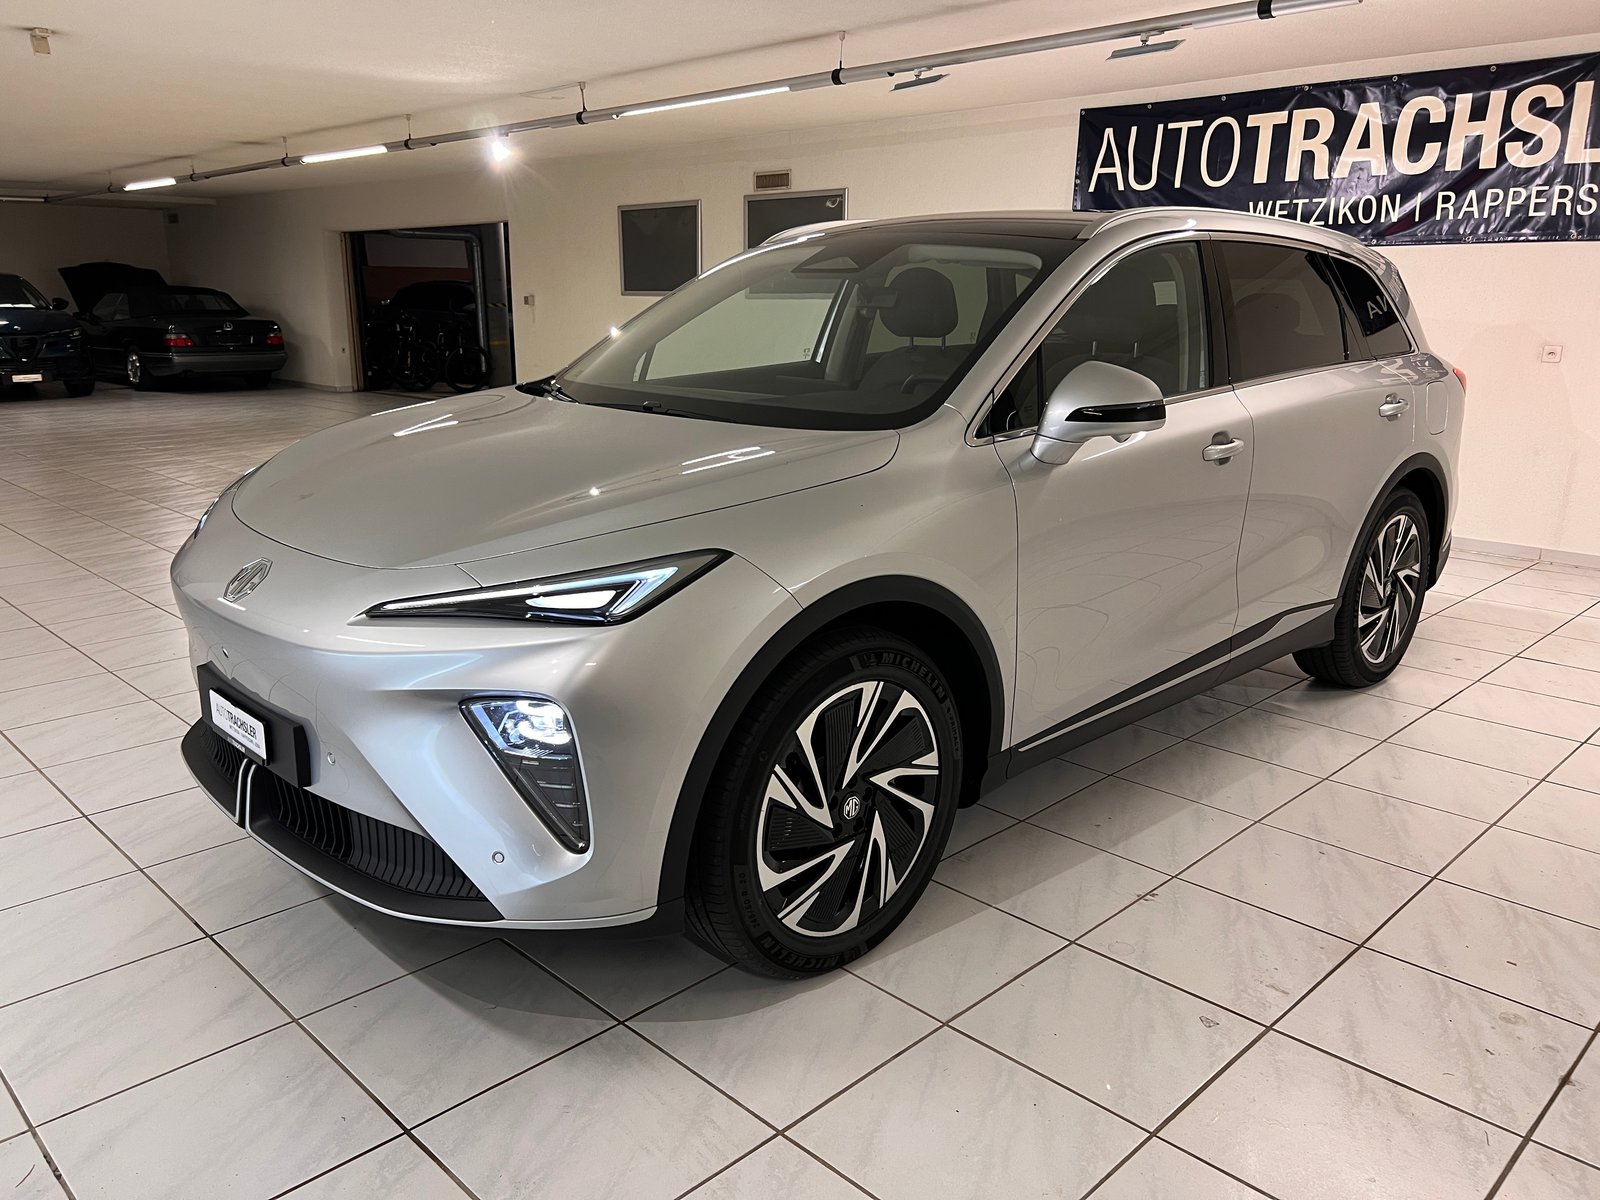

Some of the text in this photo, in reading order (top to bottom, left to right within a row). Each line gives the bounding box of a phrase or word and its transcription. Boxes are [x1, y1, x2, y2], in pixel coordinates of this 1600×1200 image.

[1087, 80, 1600, 193] AUTOTRACHSL
[1248, 193, 1402, 226] WETZIKON
[1435, 183, 1599, 222] RAPPERS
[226, 560, 270, 600] MG
[881, 652, 947, 701] MICHELIN
[845, 798, 860, 818] MG
